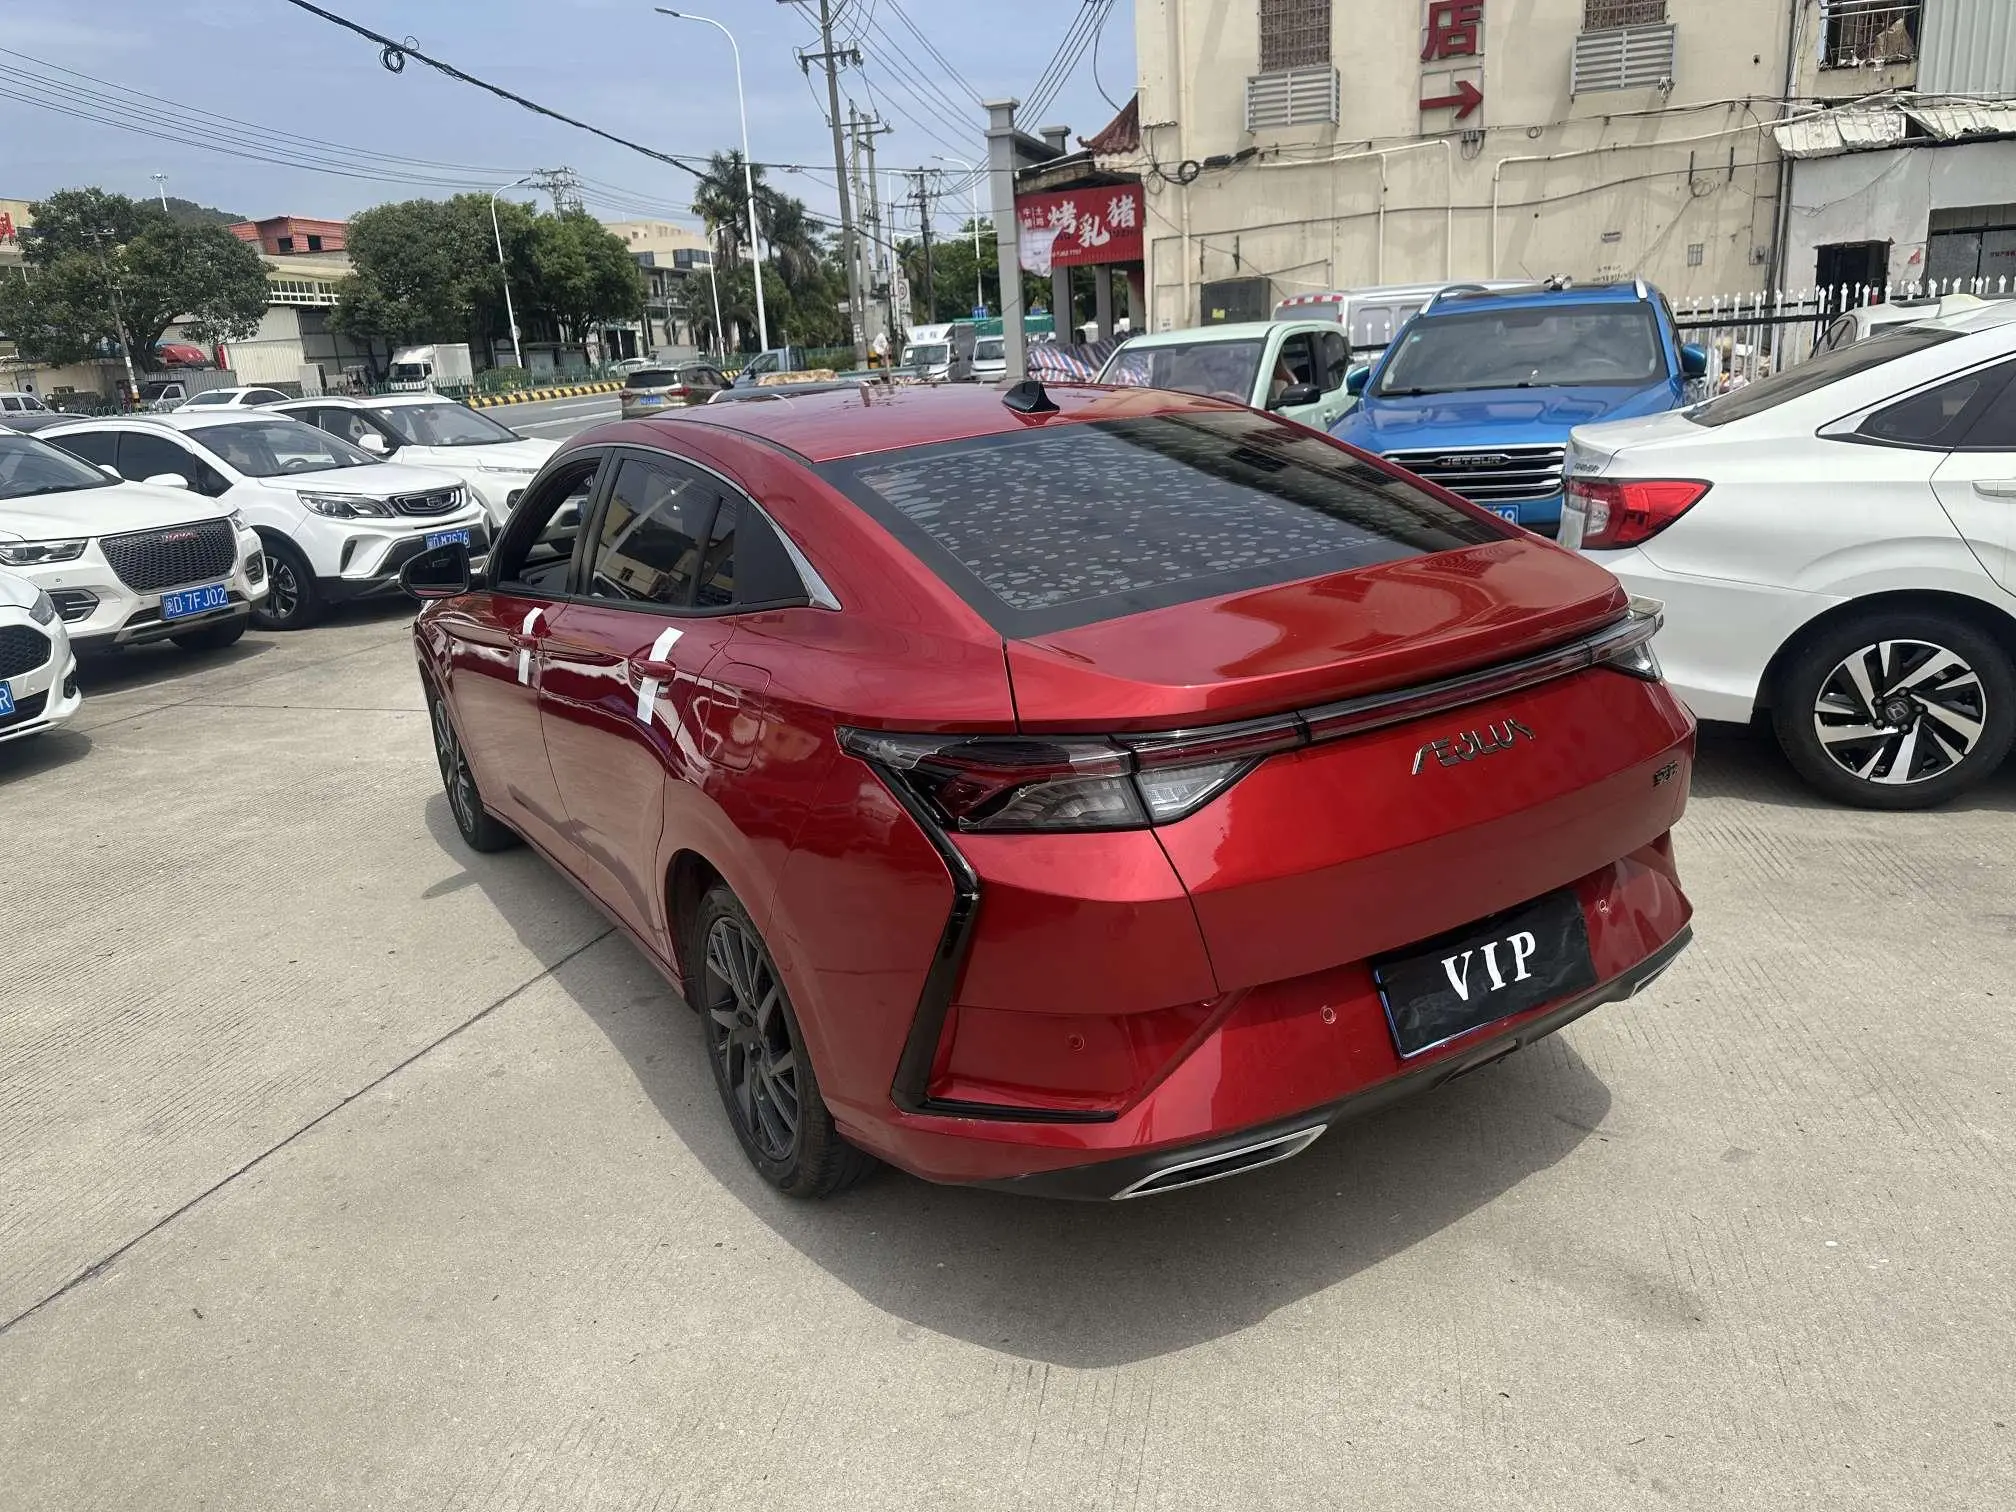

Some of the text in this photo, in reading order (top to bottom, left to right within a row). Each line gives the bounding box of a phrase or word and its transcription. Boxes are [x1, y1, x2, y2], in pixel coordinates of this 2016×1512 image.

[1420, 0, 1484, 61] 店
[1047, 194, 1136, 249] 烤乳猪
[1440, 456, 1501, 466] JETOUR
[1441, 931, 1536, 1001] VIP
